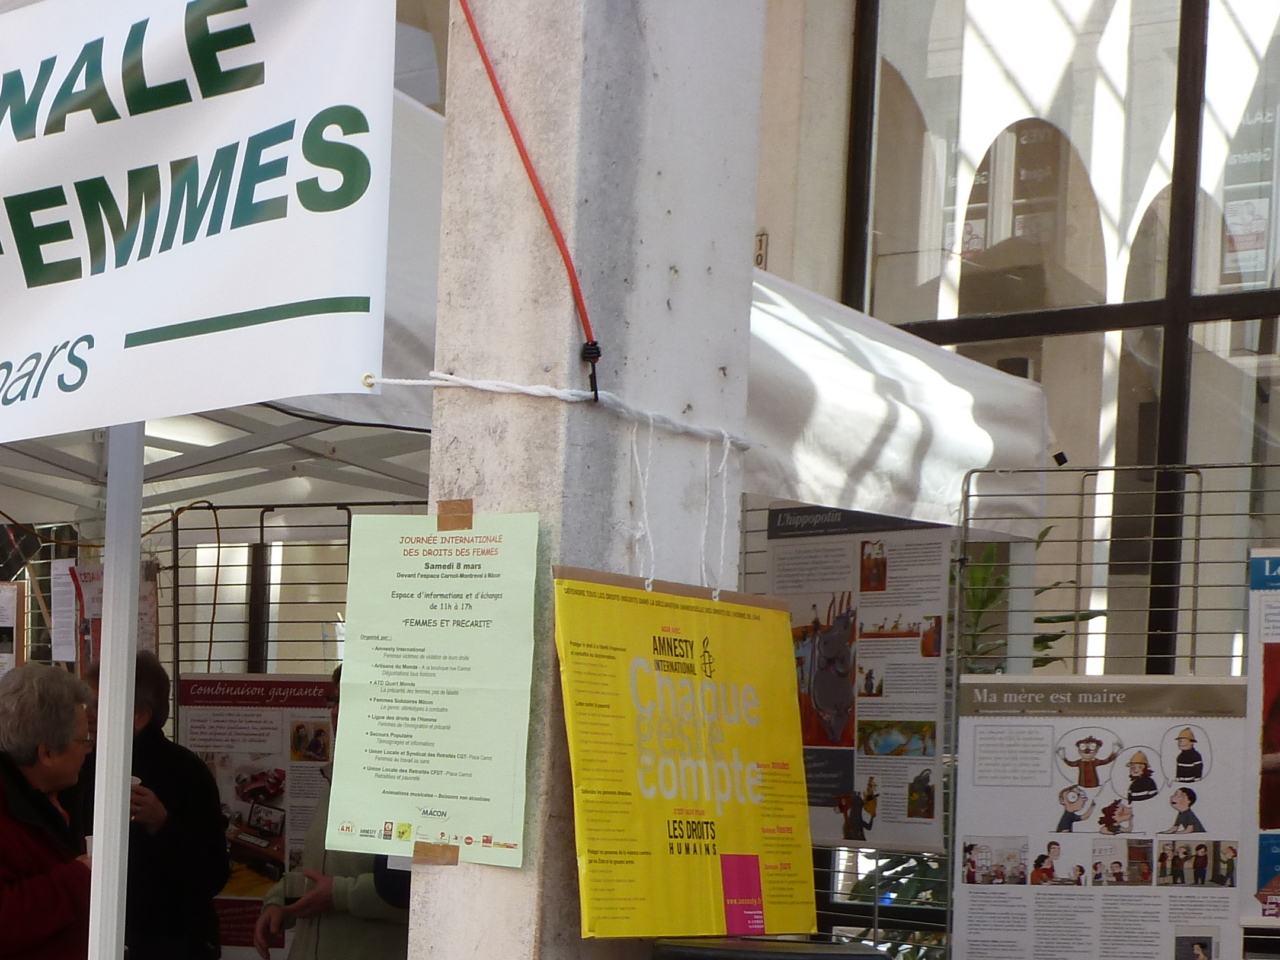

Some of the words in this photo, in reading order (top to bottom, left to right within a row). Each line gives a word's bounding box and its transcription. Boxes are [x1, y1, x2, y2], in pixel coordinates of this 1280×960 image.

[399, 534, 438, 544] JOURNÉE
[440, 535, 503, 544] INTERNATIONALE
[472, 548, 498, 556] FEMMES
[424, 562, 454, 570] Samedi
[456, 562, 461, 570] 8
[391, 591, 414, 600] Espace
[475, 592, 503, 600] d'échanges
[652, 636, 694, 659] AMNESTY
[654, 659, 697, 676] INTERNATIONAL
[190, 683, 266, 696] Combinaison
[268, 686, 324, 703] gagnante
[629, 656, 760, 730] Chaque
[974, 688, 998, 703] Ma
[1003, 688, 1044, 703] mère
[1049, 691, 1072, 703] est
[1078, 689, 1126, 703] maire
[637, 749, 765, 817] compte
[667, 819, 684, 839] LES
[686, 820, 716, 840] DROITS
[668, 842, 718, 856] HUMAINS
